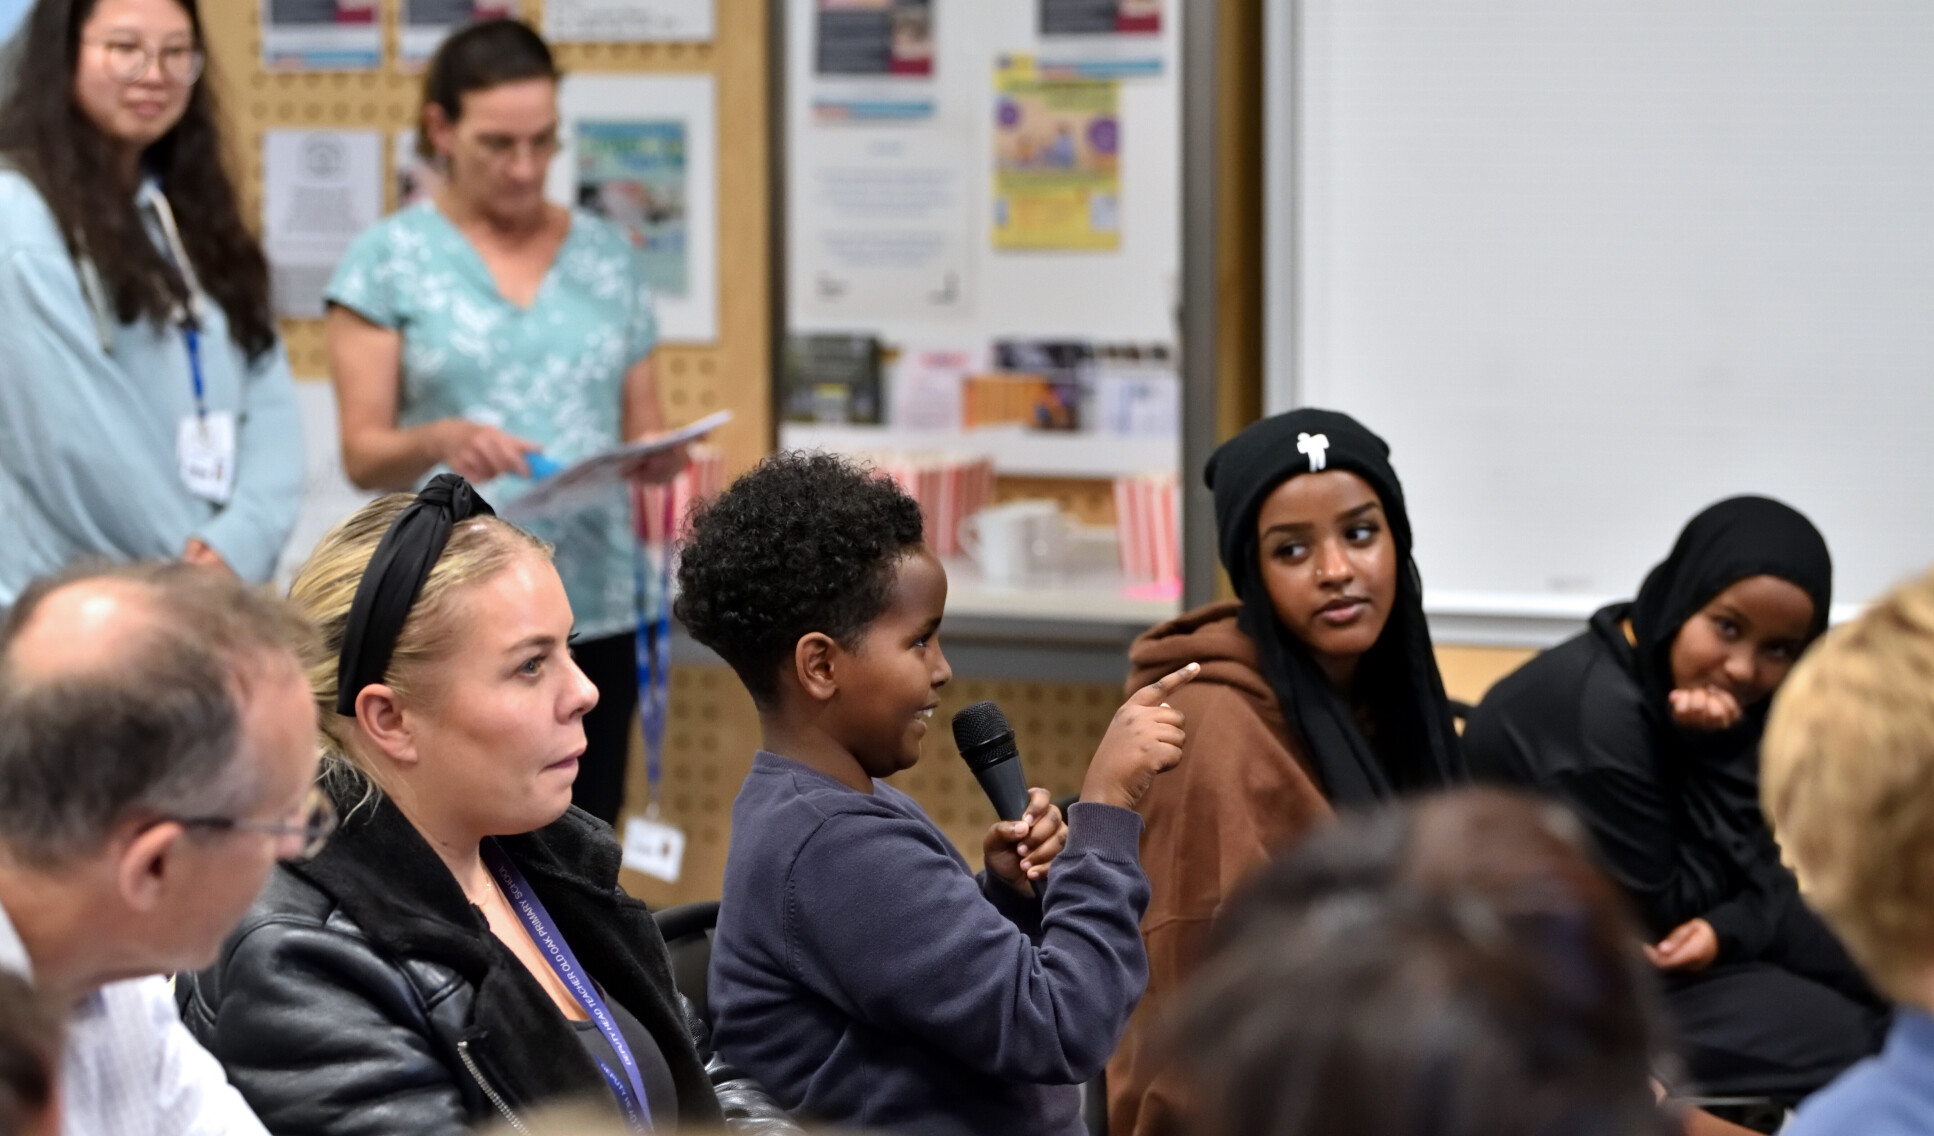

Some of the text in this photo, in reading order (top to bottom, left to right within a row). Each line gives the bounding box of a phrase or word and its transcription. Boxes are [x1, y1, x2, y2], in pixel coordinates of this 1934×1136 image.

[499, 865, 632, 1066] DEPUTY HEAD TEACHER OLD OAK PRIMARY SCHOOL
